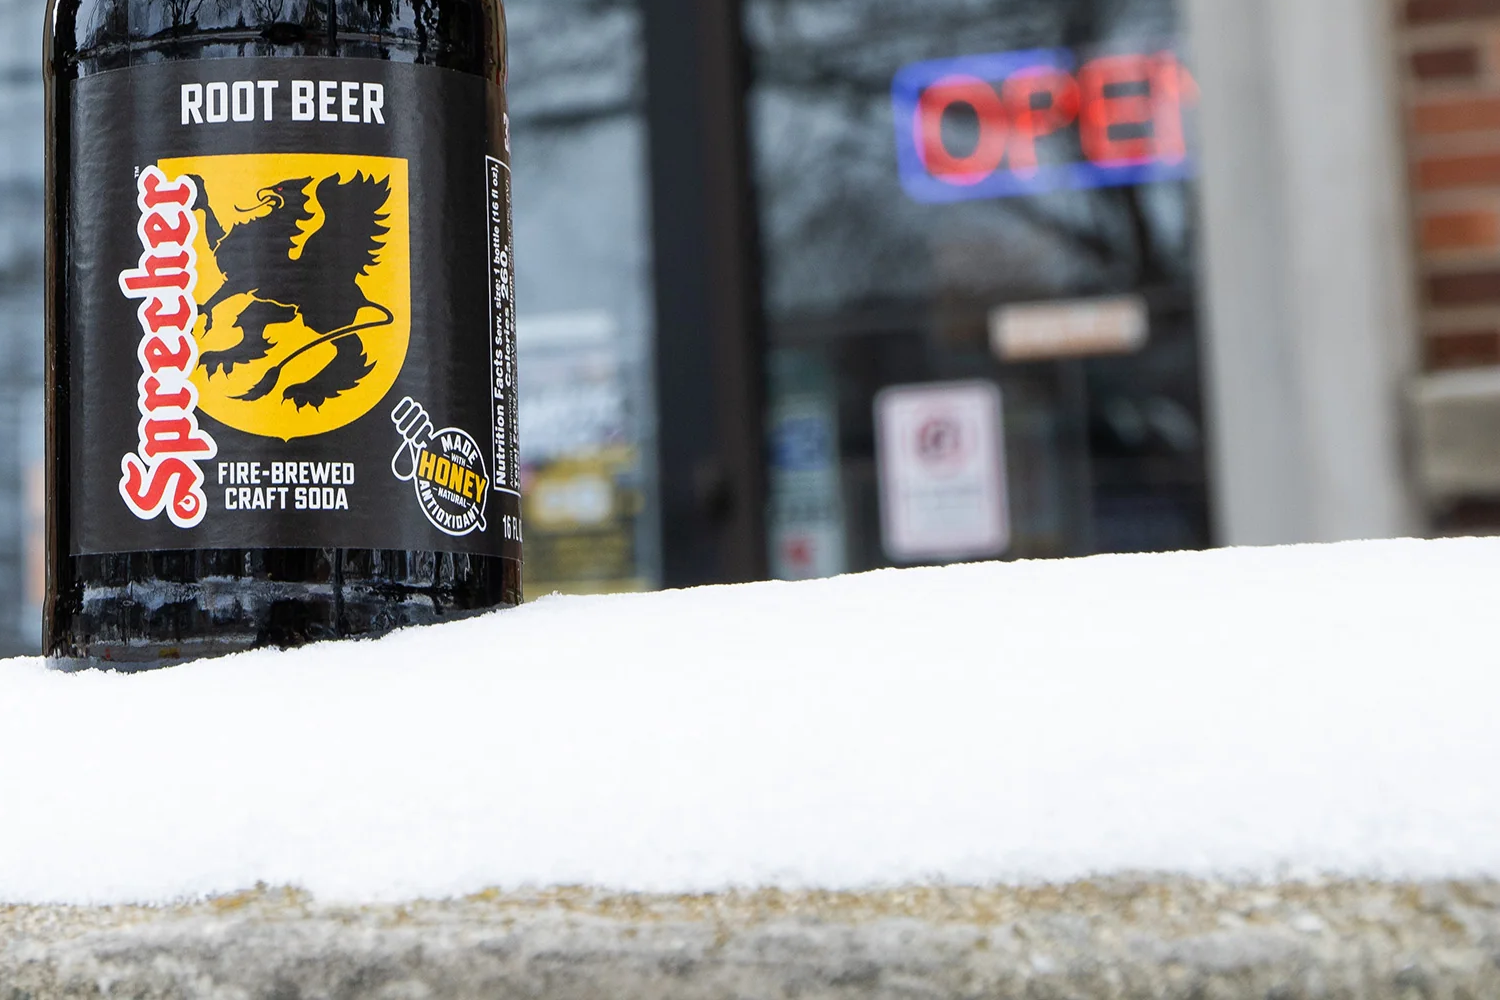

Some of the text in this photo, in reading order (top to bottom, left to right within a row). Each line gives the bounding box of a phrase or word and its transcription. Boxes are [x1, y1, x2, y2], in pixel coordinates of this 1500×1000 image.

[180, 80, 385, 125] ROOT BEER
[491, 203, 500, 223] (16
[492, 226, 501, 264] bottle
[493, 267, 500, 275] 1
[493, 279, 502, 309] size:
[494, 313, 503, 345] Serv.
[120, 168, 215, 526] Sprecher
[503, 308, 512, 387] Calories
[493, 349, 505, 399] Facts
[440, 433, 478, 466] MADE
[451, 453, 466, 467] WITH
[494, 405, 507, 485] Nutrition
[218, 462, 355, 485] FIRE-BREWED
[418, 450, 487, 503] HONEY
[225, 487, 349, 511] CRAFT SODA
[419, 480, 480, 529] ANTIOXIDANT
[438, 487, 467, 508] NATURAL
[502, 514, 511, 540] 16
